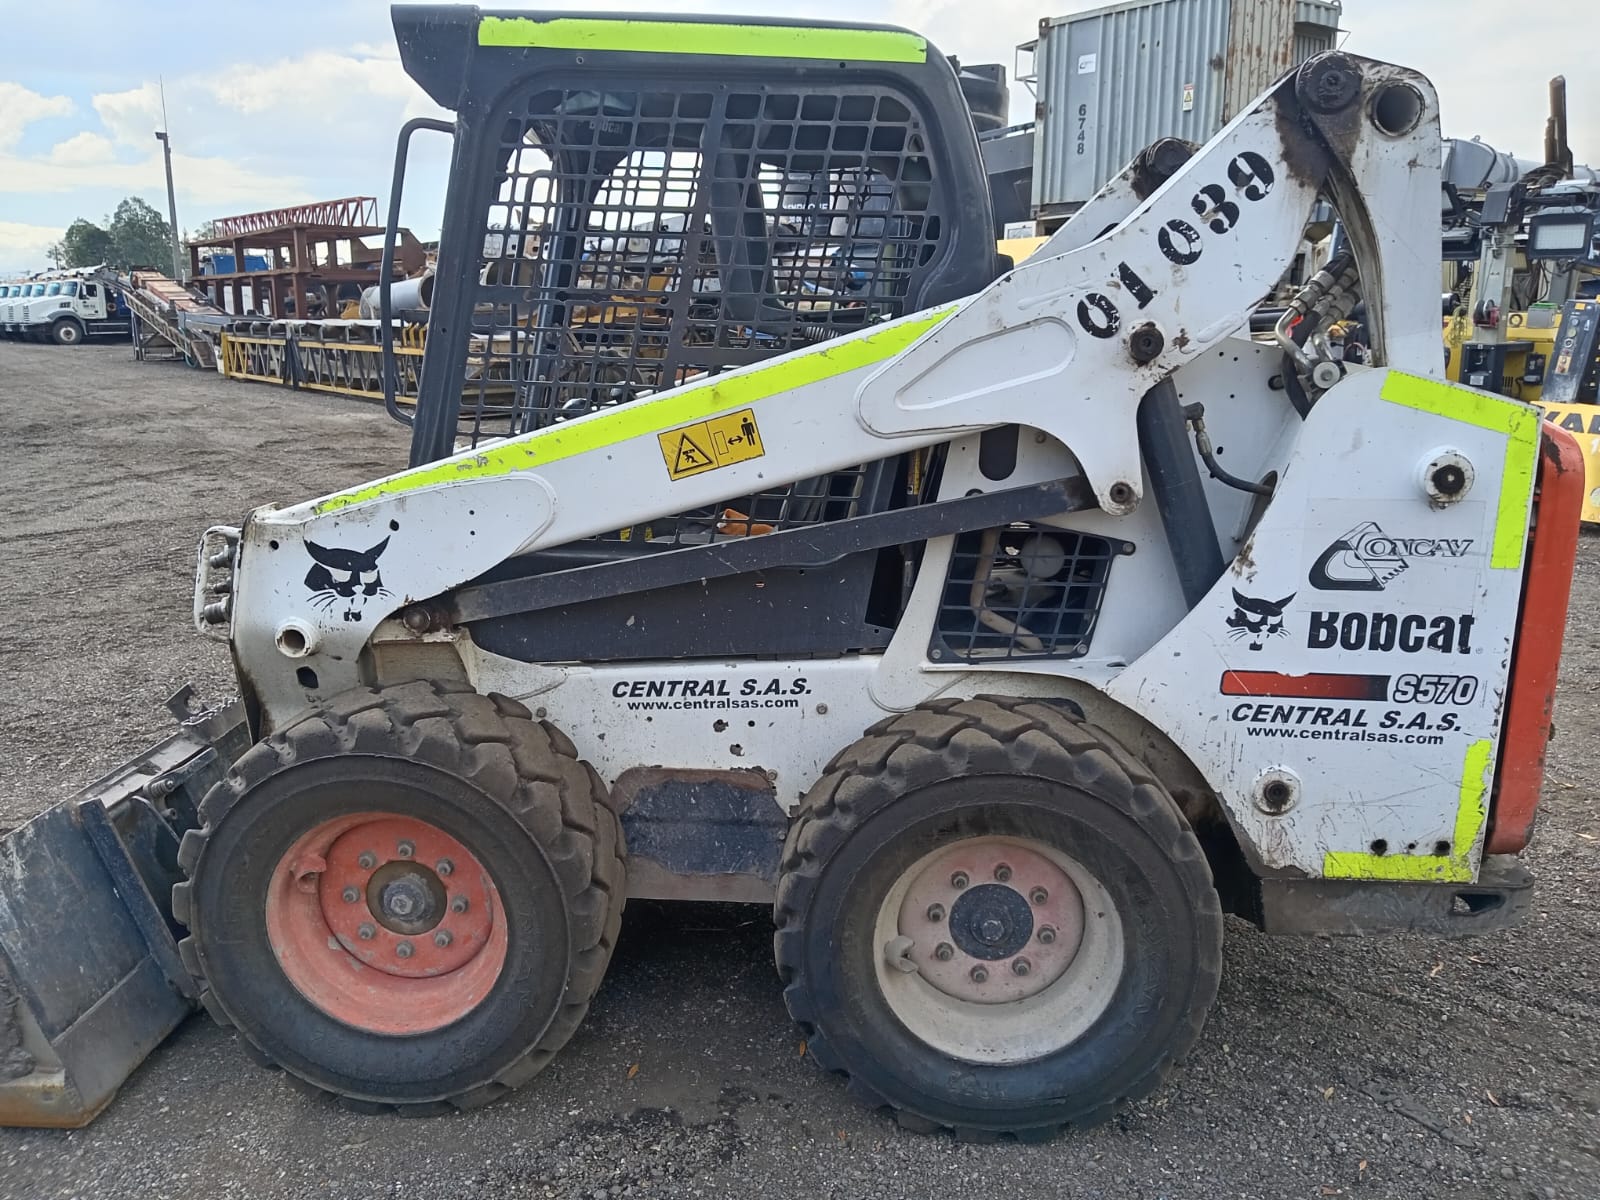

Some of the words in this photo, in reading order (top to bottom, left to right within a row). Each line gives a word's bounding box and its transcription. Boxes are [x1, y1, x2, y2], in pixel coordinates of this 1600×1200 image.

[1077, 103, 1087, 155] 6748
[1307, 611, 1475, 655] Bobcat
[612, 680, 731, 698] CENTRAL
[740, 678, 813, 696] S.A.S.
[1393, 673, 1479, 705] S570
[627, 698, 799, 710] www.centralsas.com
[1231, 703, 1369, 727] CENTRAL
[1379, 710, 1462, 732] S.A.S.
[1246, 727, 1444, 745] www.centralsas.com
